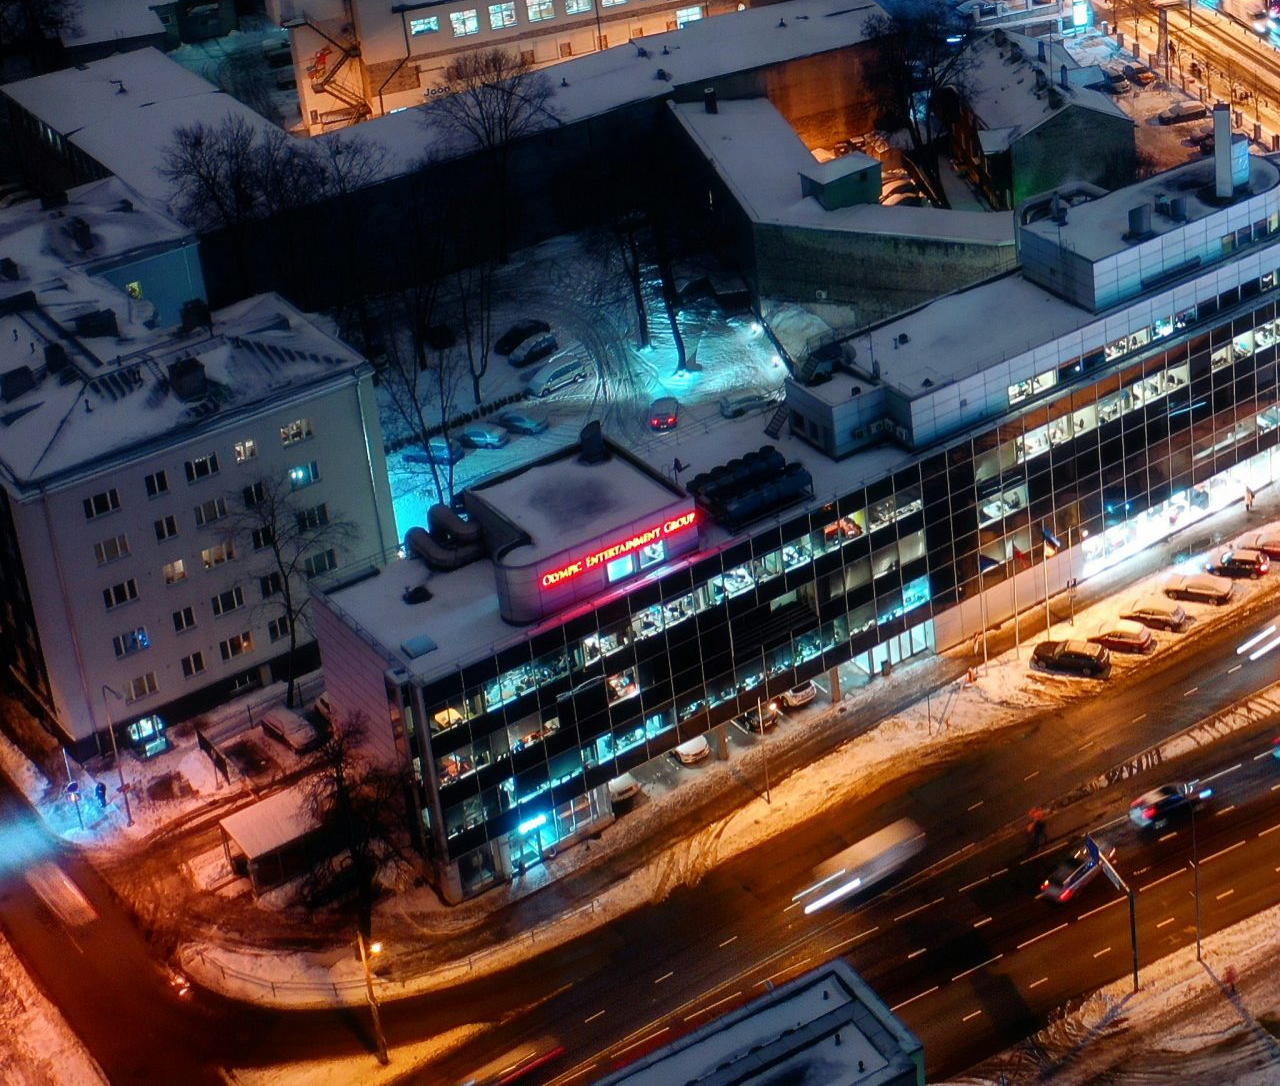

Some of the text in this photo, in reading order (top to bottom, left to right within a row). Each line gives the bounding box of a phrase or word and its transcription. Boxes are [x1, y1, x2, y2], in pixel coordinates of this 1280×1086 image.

[542, 513, 696, 586] OLYMPIC ENTERTAINMENT GROUP
